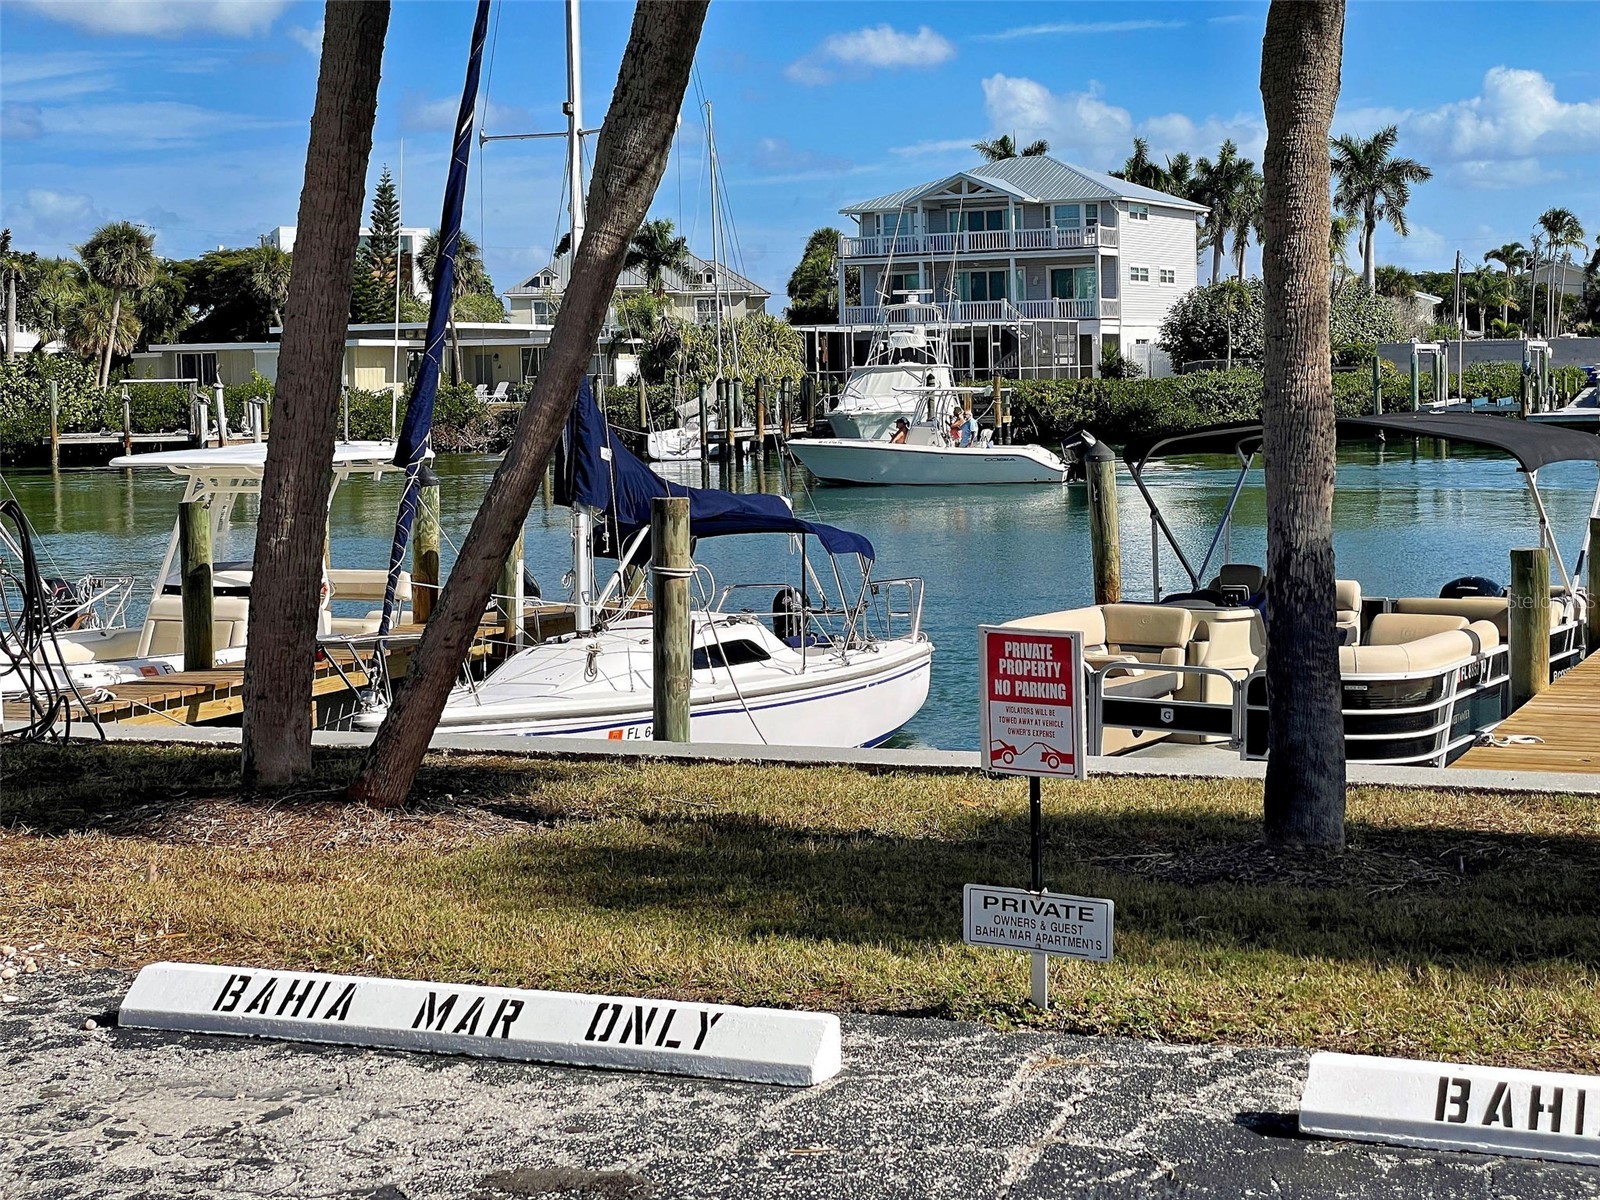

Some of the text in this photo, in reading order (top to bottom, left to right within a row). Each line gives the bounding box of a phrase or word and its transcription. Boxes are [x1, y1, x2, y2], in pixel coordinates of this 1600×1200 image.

[1004, 641, 1053, 660] PRIVATE
[998, 658, 1061, 679] PROPERTY
[994, 679, 1067, 700] NO PARKING
[999, 716, 1064, 728] TOWED AWAY AT VEHICLE
[1005, 706, 1055, 717] VIOLATORS WILL BE
[627, 727, 641, 740] FL
[1007, 727, 1056, 738] OWNER'S EXPENSE
[983, 895, 1094, 922] PRIVATE
[993, 914, 1084, 936] OWNERS & GUEST
[975, 925, 1102, 951] BAHIA MAR APARTMENTS
[212, 974, 724, 1051] BAHIA MAR ONLY
[1434, 1076, 1600, 1136] BAHI
